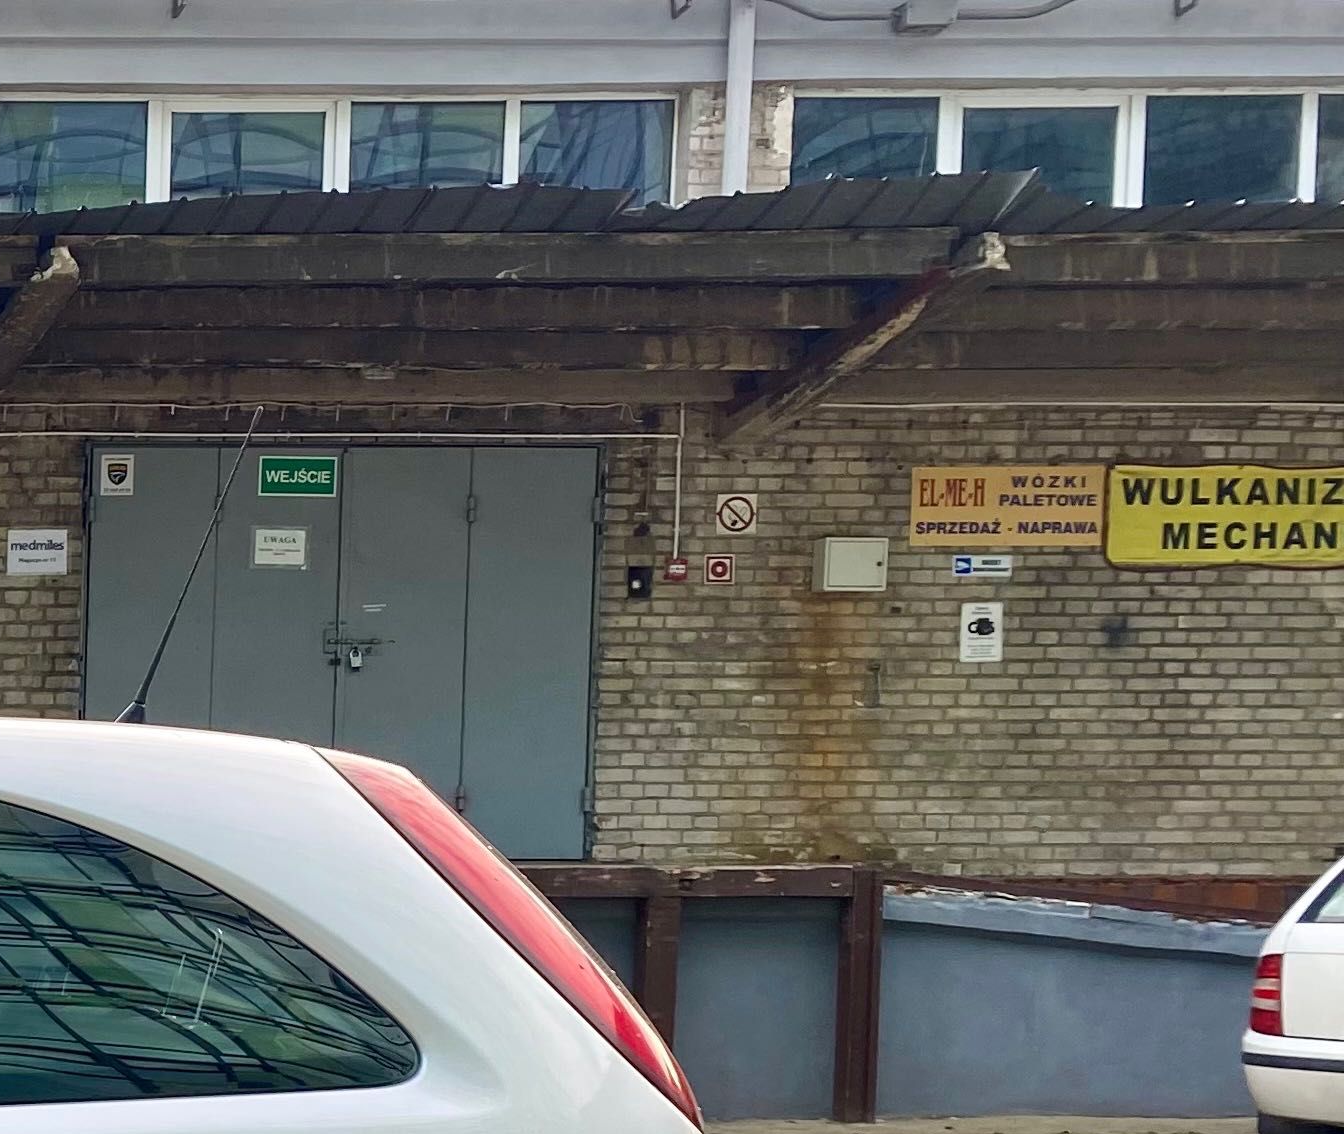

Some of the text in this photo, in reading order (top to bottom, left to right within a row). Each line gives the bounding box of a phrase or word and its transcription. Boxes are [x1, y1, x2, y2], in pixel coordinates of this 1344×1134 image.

[265, 468, 331, 484] WEJŚCIE
[1012, 473, 1087, 488] WÓZKI
[1121, 477, 1344, 506] WULKANIZ
[998, 494, 1098, 507] PALETOWE
[915, 518, 1002, 534] SPRZEDAŻ
[1017, 521, 1098, 534] NAPRAWA
[263, 536, 297, 544] UWAGA
[1161, 522, 1338, 550] MECHAN
[11, 539, 65, 551] medmiles
